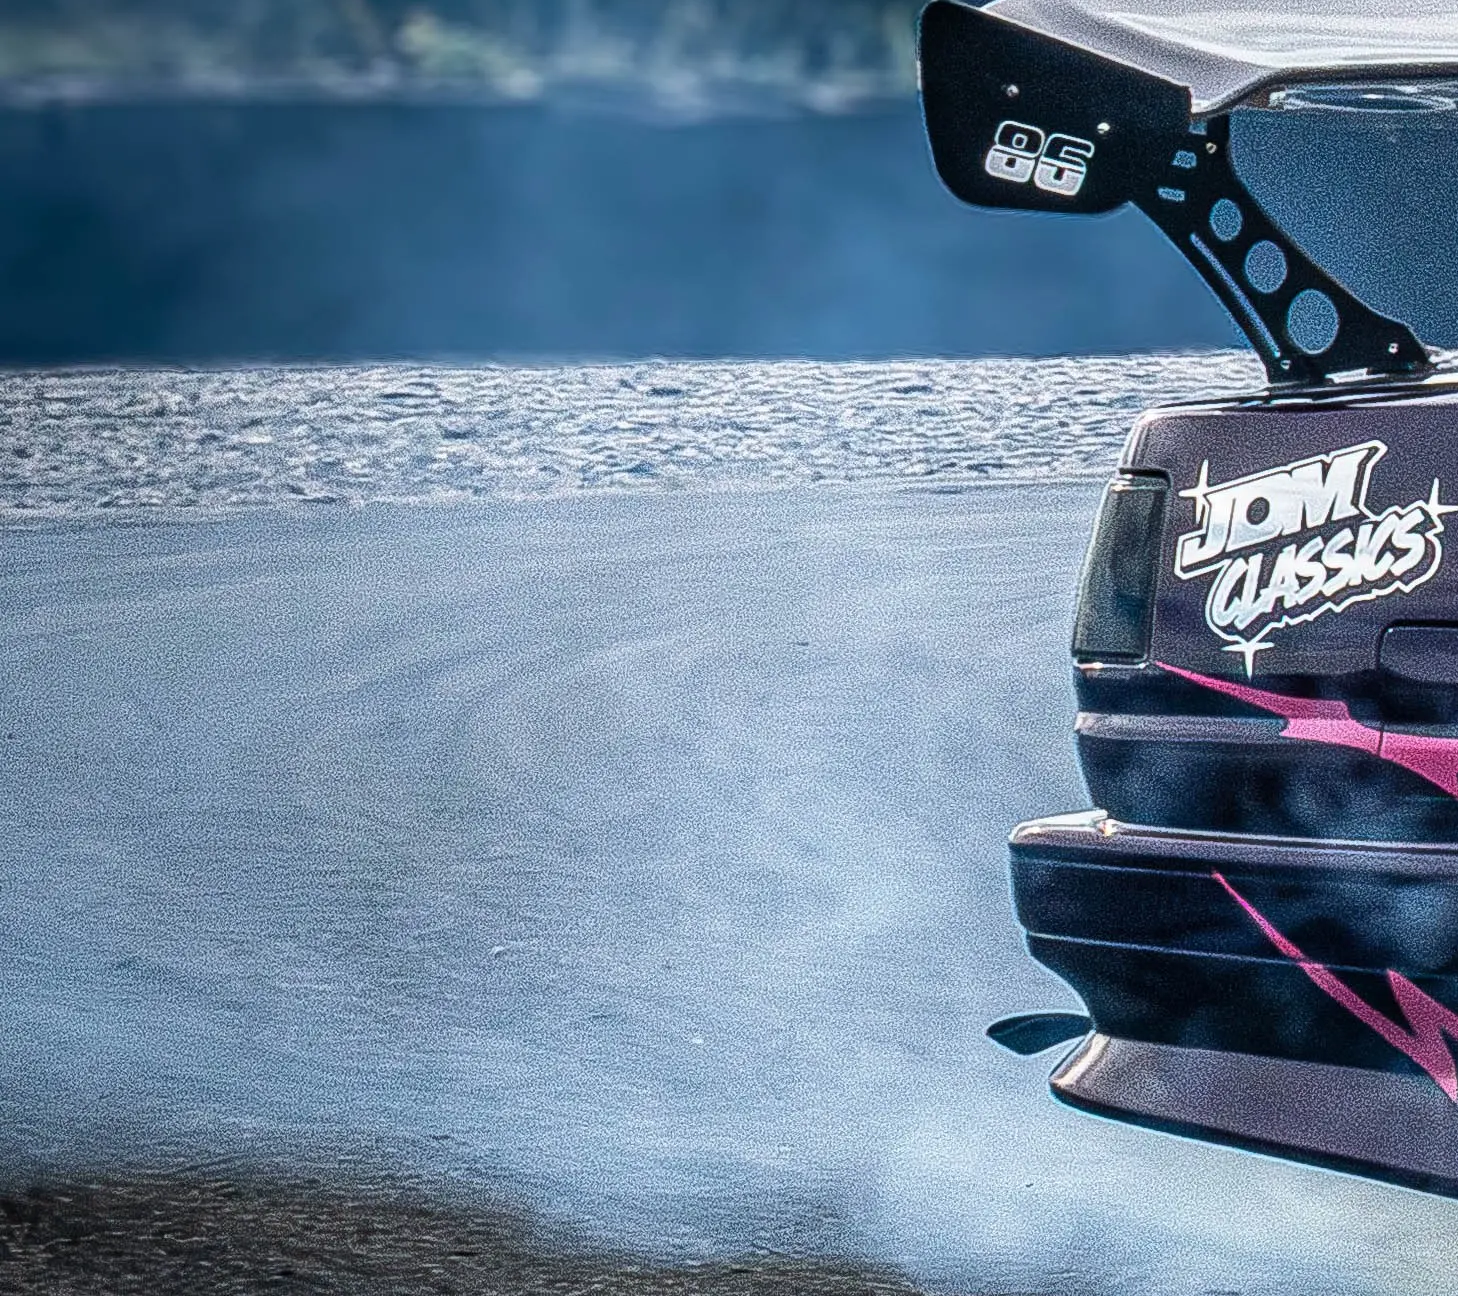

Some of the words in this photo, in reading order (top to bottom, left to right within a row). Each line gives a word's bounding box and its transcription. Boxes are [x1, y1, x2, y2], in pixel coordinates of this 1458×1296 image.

[985, 119, 1094, 196] 86
[1179, 447, 1370, 568] JDM
[1209, 507, 1426, 631] CLASSICS
